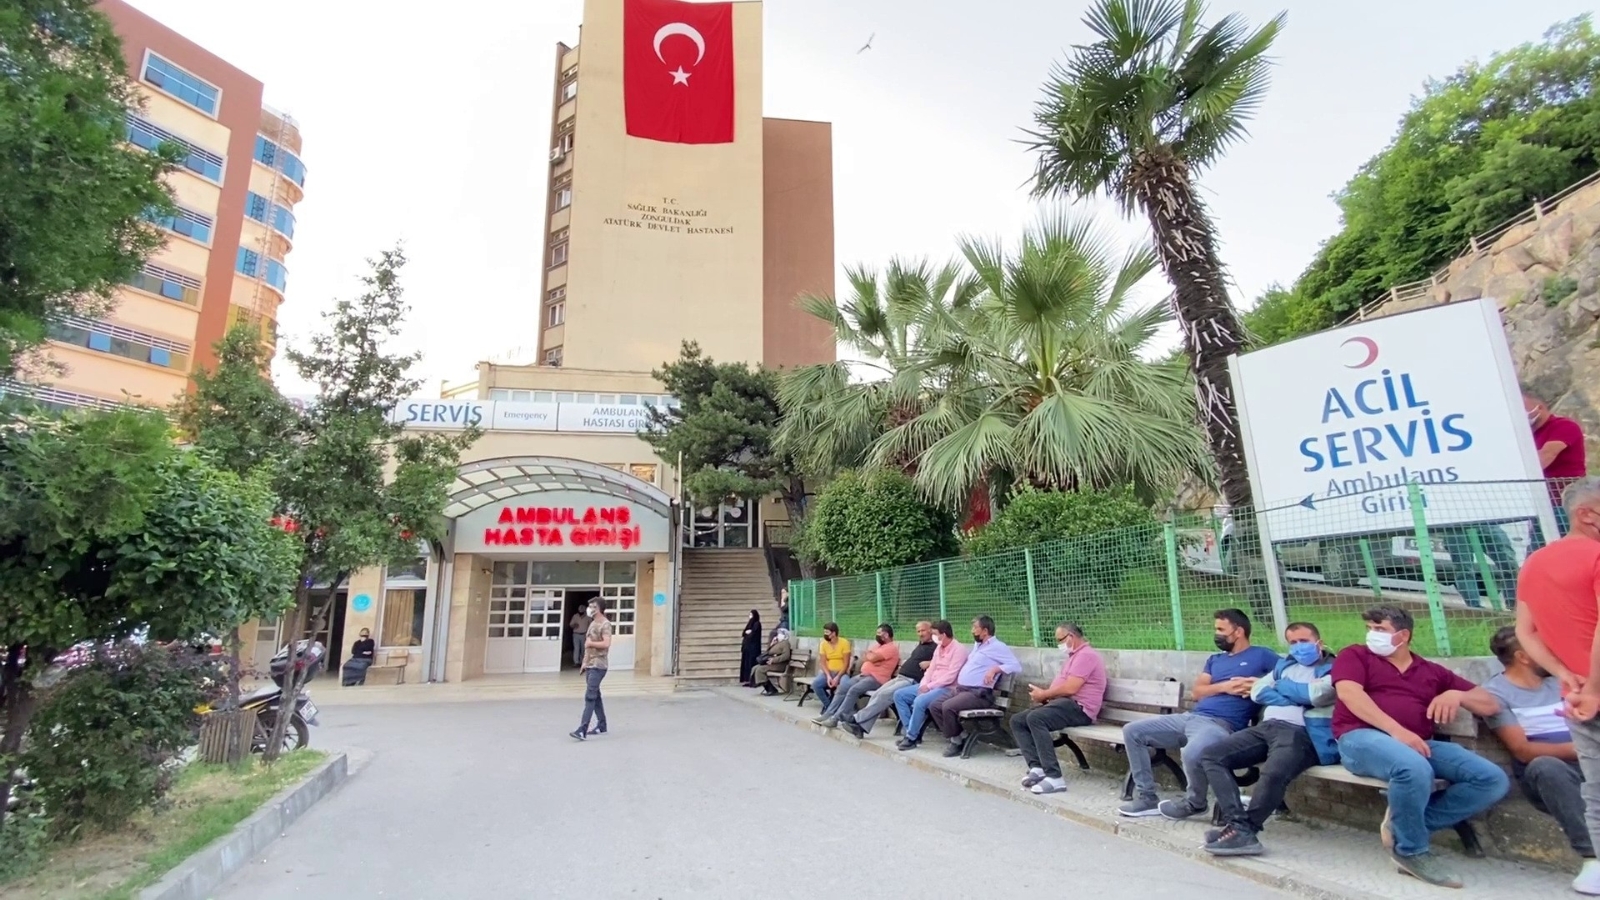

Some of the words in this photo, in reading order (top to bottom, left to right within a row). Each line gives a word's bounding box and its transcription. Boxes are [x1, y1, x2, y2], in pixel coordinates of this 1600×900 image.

[627, 203, 657, 213] SAĞLIK
[662, 207, 707, 217] BAKANLIĞI
[641, 213, 691, 225] ZONGULDAK
[603, 217, 642, 228] ATATÜRK
[648, 222, 681, 233] DEVLET
[687, 226, 734, 234] HASTANESİ
[1321, 369, 1429, 424] ACİL
[406, 402, 482, 425] SERVİS
[503, 411, 548, 421] Emergency
[583, 418, 624, 428] HASTASI
[1299, 408, 1473, 473] SERVİS
[1326, 466, 1459, 497] Ambulans
[1361, 489, 1428, 514] Girii
[498, 506, 631, 525] AMBULANS
[484, 527, 564, 546] HASTA
[569, 524, 641, 550] GİRİŞİ
